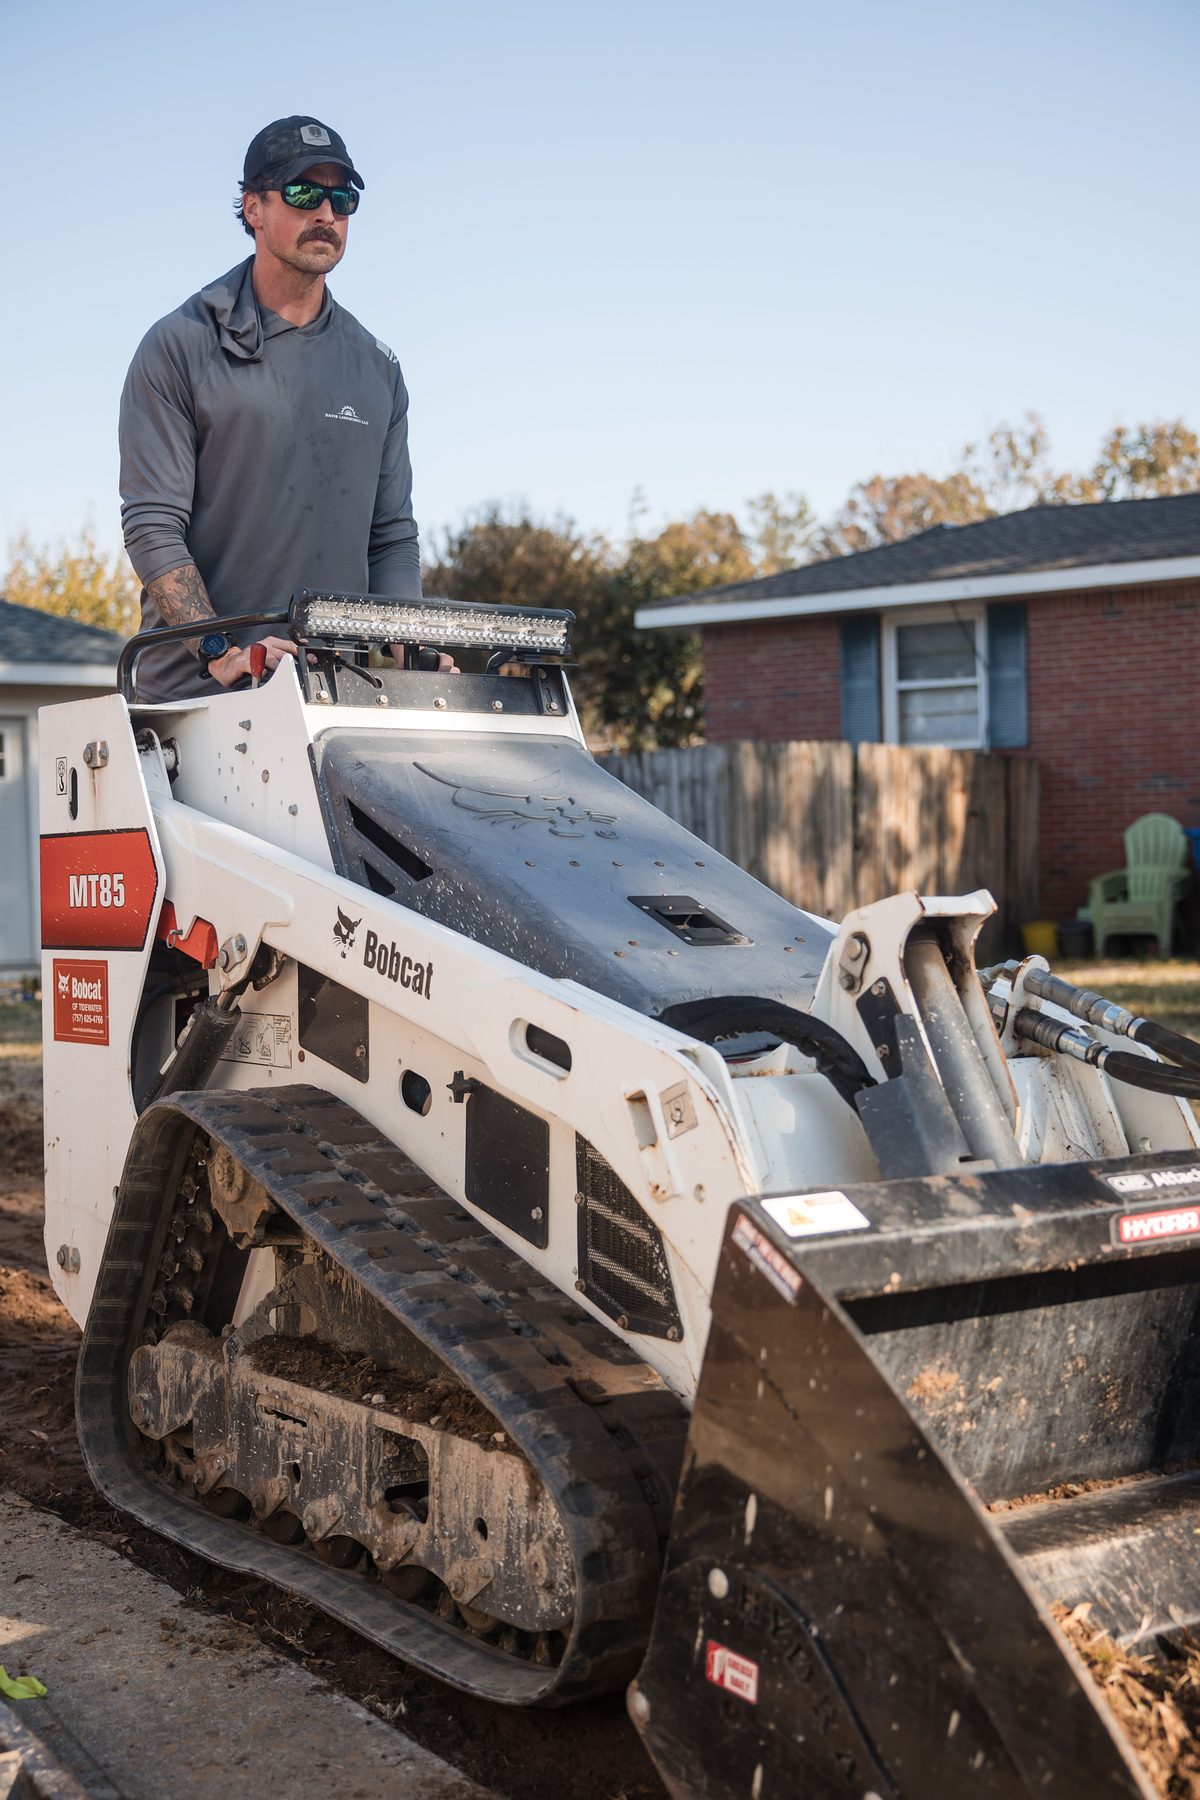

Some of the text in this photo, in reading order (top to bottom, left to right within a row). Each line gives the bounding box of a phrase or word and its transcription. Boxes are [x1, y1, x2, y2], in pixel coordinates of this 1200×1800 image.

[69, 873, 125, 908] MT85
[363, 929, 433, 1000] Bobcat
[71, 977, 102, 1000] Bobcat
[71, 1002, 102, 1013] OF TIDEWATER
[72, 1013, 83, 1024] (757)
[1122, 1211, 1199, 1239] HYDRA
